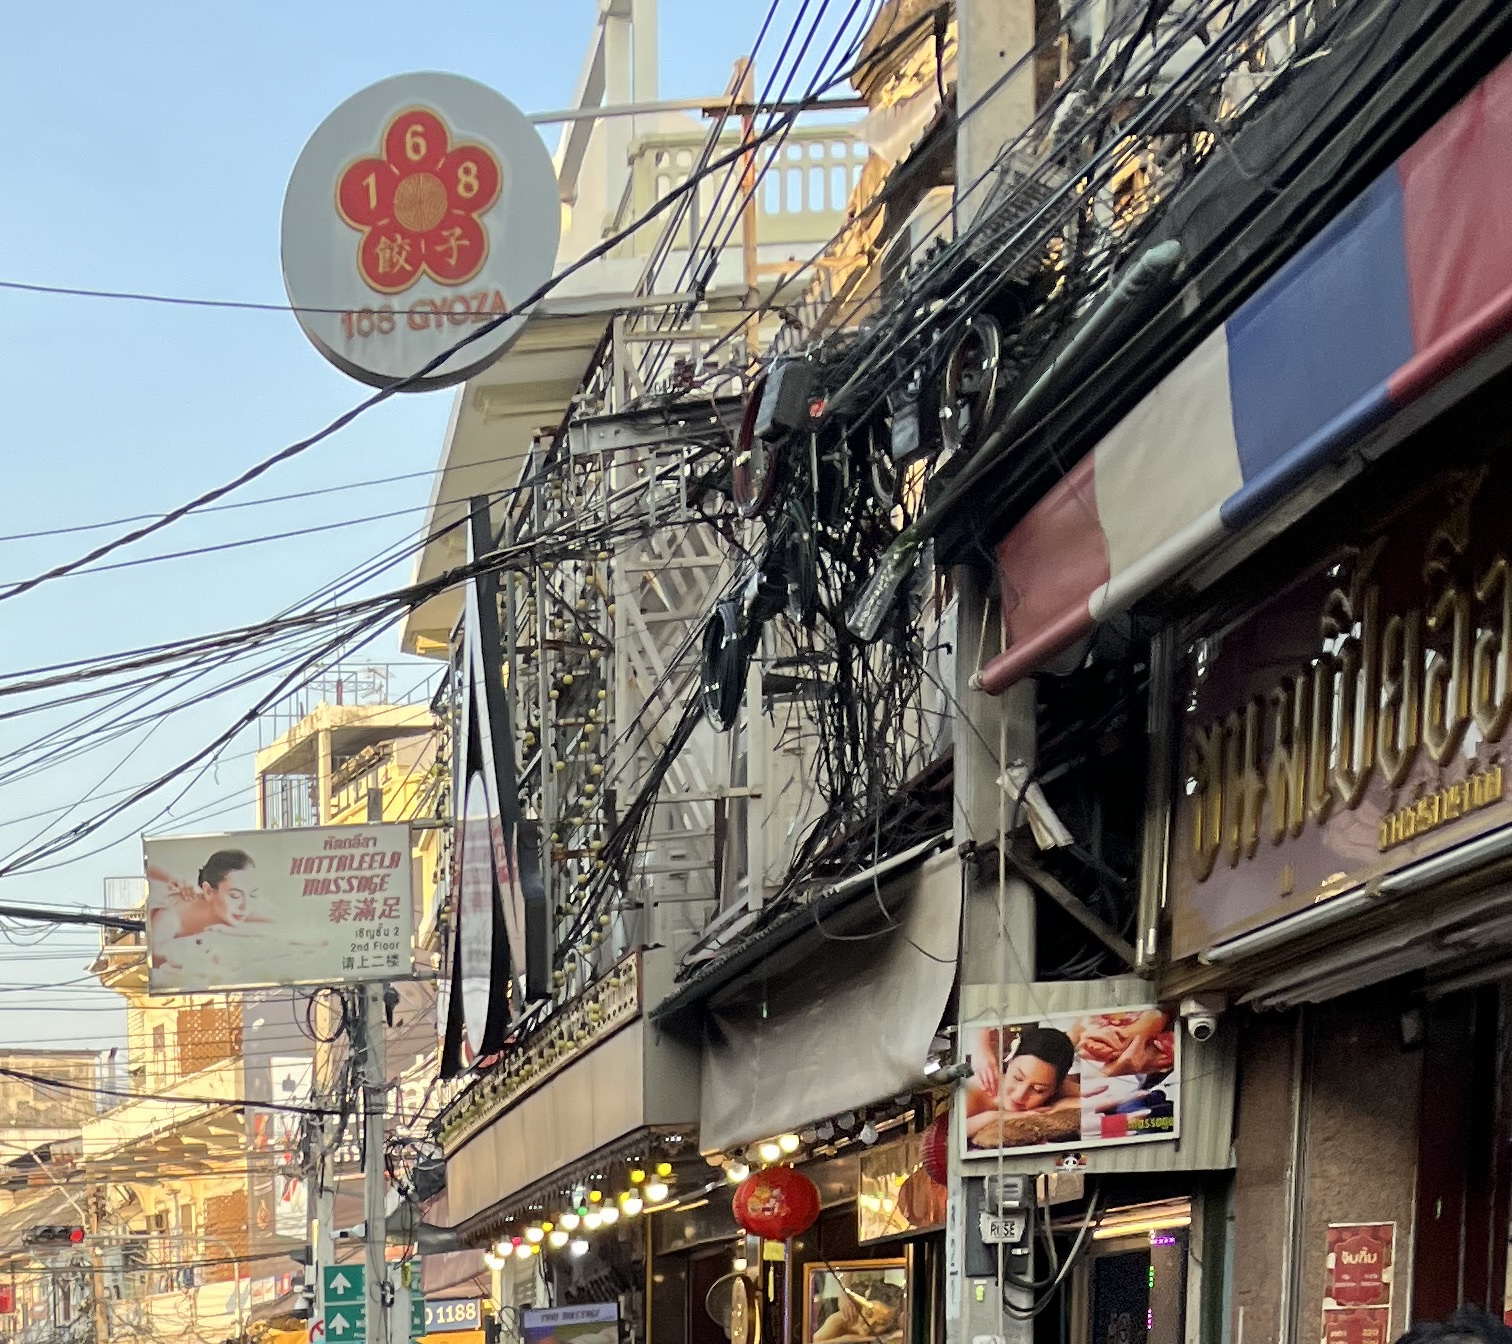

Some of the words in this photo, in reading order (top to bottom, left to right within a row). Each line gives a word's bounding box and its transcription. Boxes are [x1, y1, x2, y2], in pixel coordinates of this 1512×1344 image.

[407, 289, 508, 331] GYOZA
[303, 873, 392, 897] MASSAGE
[350, 941, 369, 952] 2nd
[373, 940, 400, 951] Floor
[437, 1302, 477, 1324] 1188
